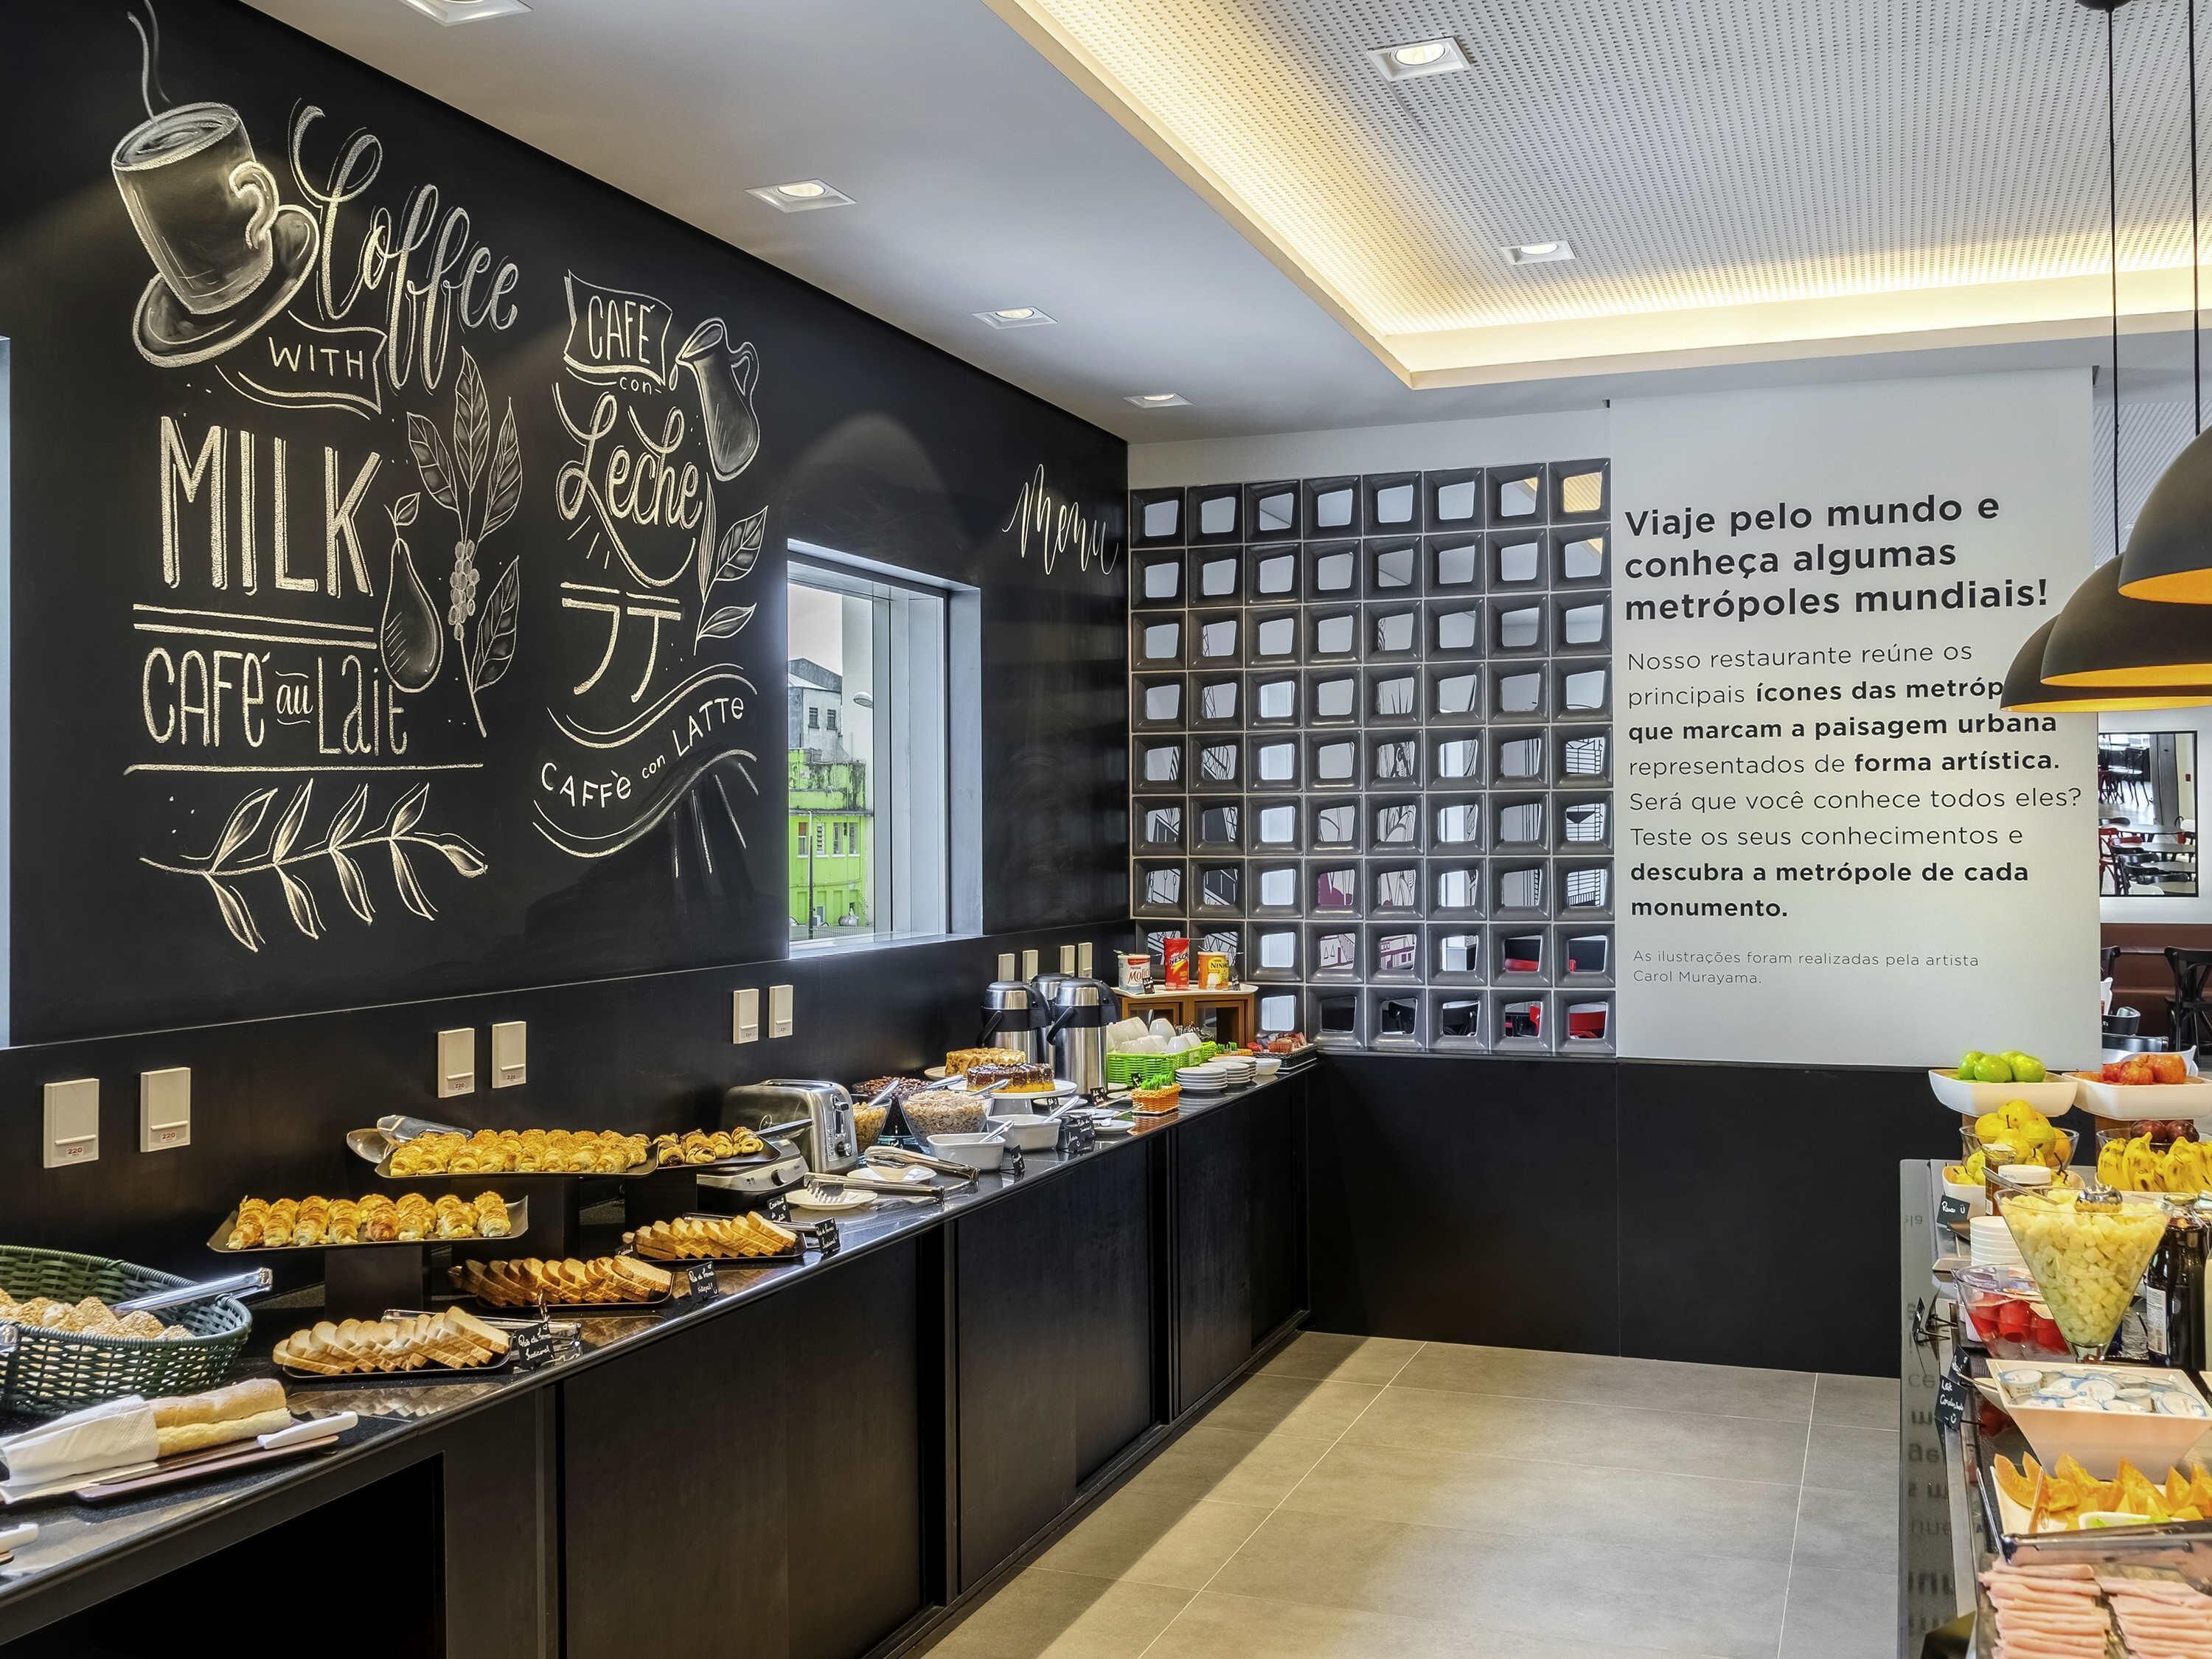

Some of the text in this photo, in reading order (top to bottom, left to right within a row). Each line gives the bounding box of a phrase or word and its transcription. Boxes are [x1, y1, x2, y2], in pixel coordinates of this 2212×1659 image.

[288, 98, 519, 394] Coffee
[268, 336, 365, 381] WITH
[619, 376, 653, 394] con
[552, 383, 703, 588] Leche
[160, 415, 382, 597] MILK
[1001, 463, 1119, 575] Menu
[1625, 495, 1999, 539] Viaje pelo mundo e
[1626, 544, 1955, 579] conheça algumas
[1627, 579, 2046, 622] metrópoles mundiais!
[1630, 644, 1971, 670] Nosso restaurante reúne os
[276, 684, 313, 716] au
[1630, 677, 2001, 709] principais ícones das metróp
[1629, 714, 2056, 743] que marcam a paisagem urbana
[641, 754, 667, 779] con
[1630, 751, 2059, 779] representados de forma artística.
[1630, 787, 2081, 813] Será que você conhece todos eles?
[1630, 827, 2023, 845] Teste os seus conhecimentos e
[1631, 862, 2028, 884] descubra a metrópole de cada
[1632, 900, 1787, 917] monumento.
[1634, 950, 1978, 967] As ilustrações foram realizadas pela artista
[1634, 970, 1761, 984] Carol Murayama.
[67, 1147, 83, 1155] 220
